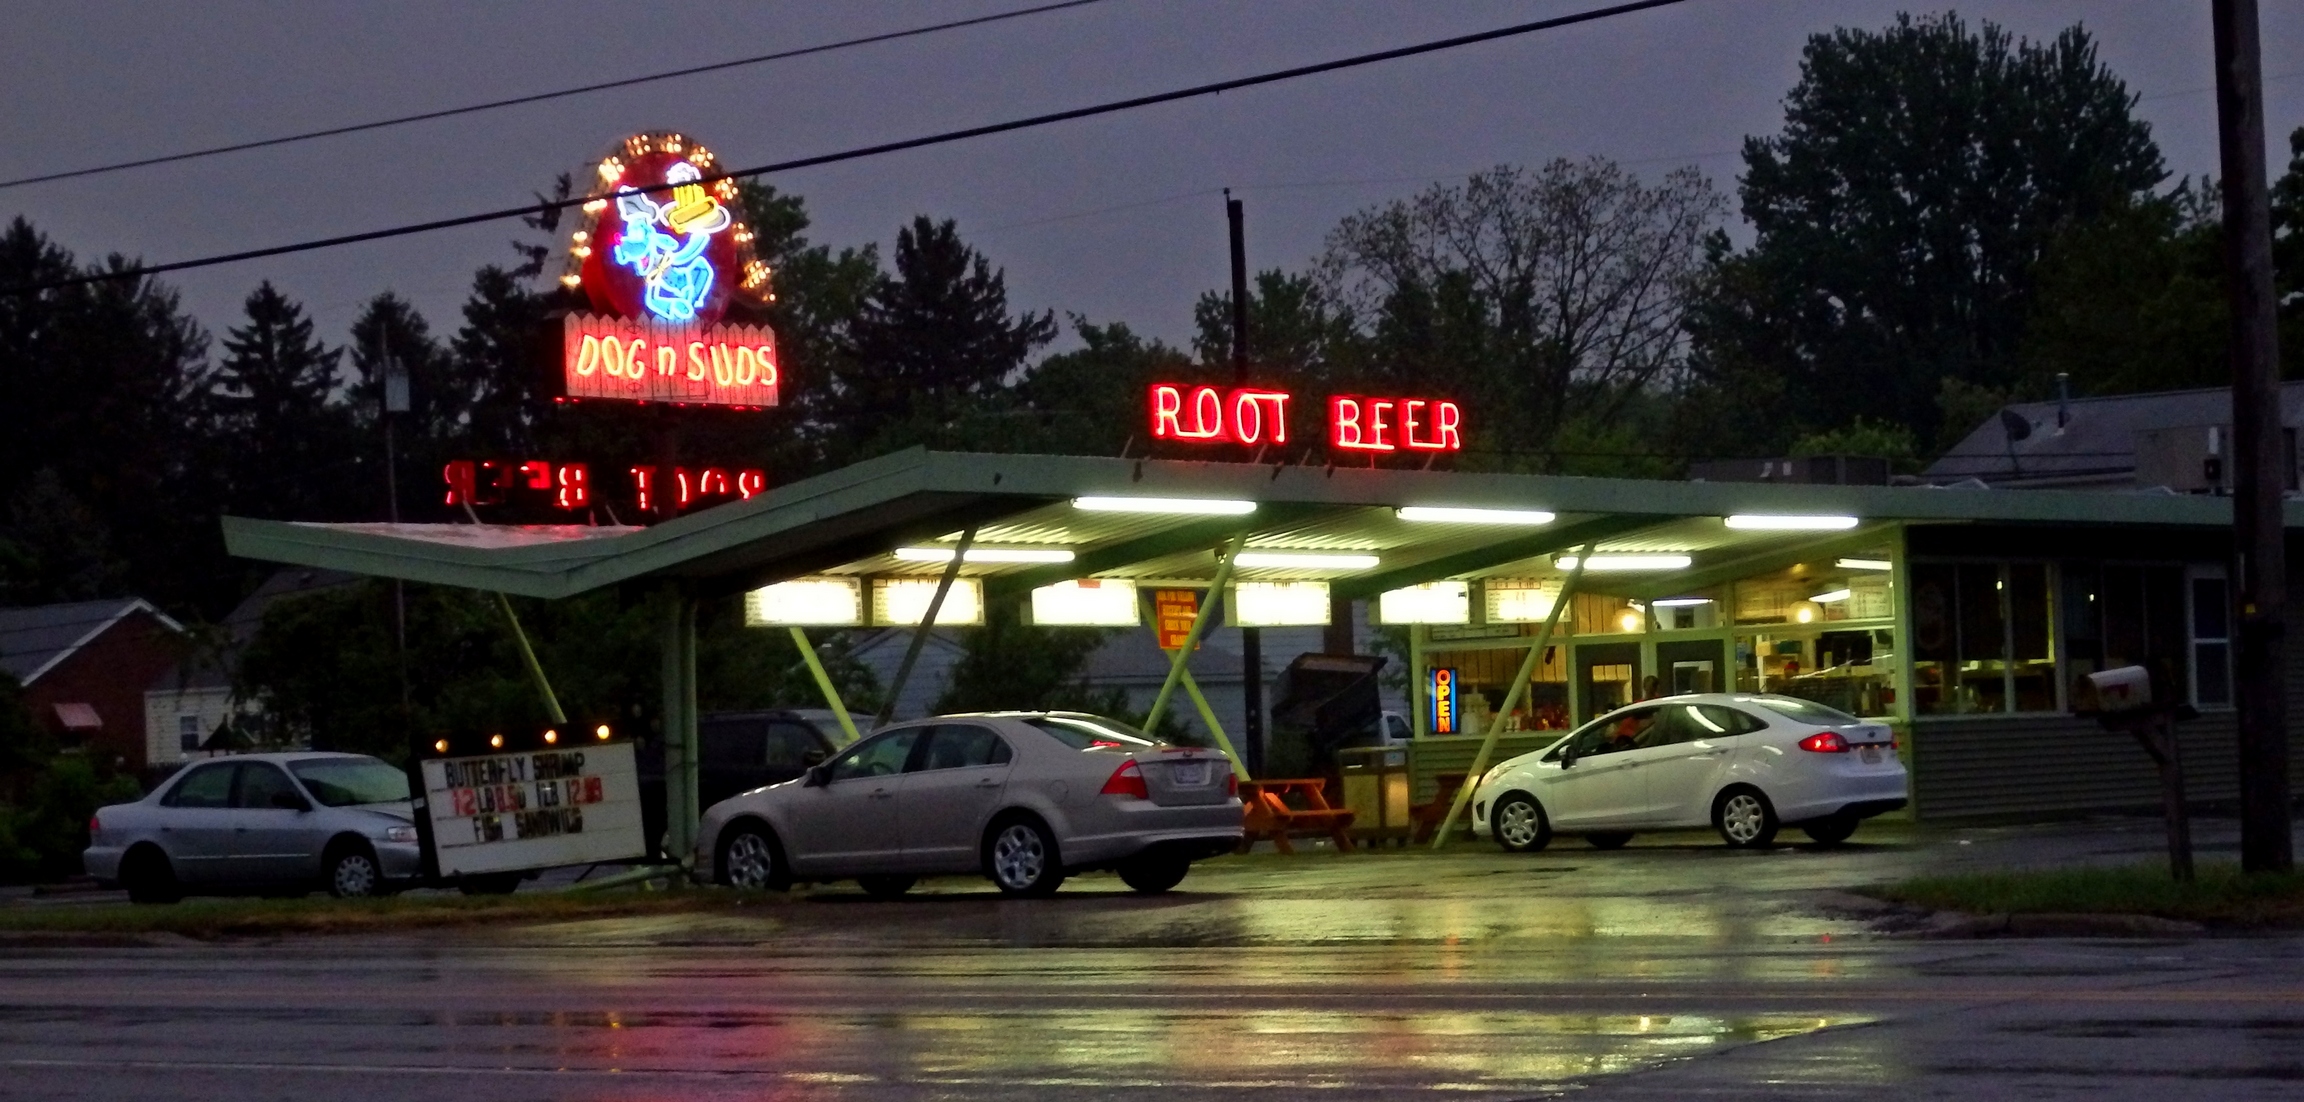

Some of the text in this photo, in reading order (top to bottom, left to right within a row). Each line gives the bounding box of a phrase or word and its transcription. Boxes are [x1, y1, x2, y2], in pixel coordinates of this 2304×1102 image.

[576, 334, 778, 387] DOG n SUDS
[1153, 385, 1461, 450] ROOT BEER
[1436, 669, 1451, 733] OPEN
[445, 753, 585, 787] BUTTERFLY SHRIMP
